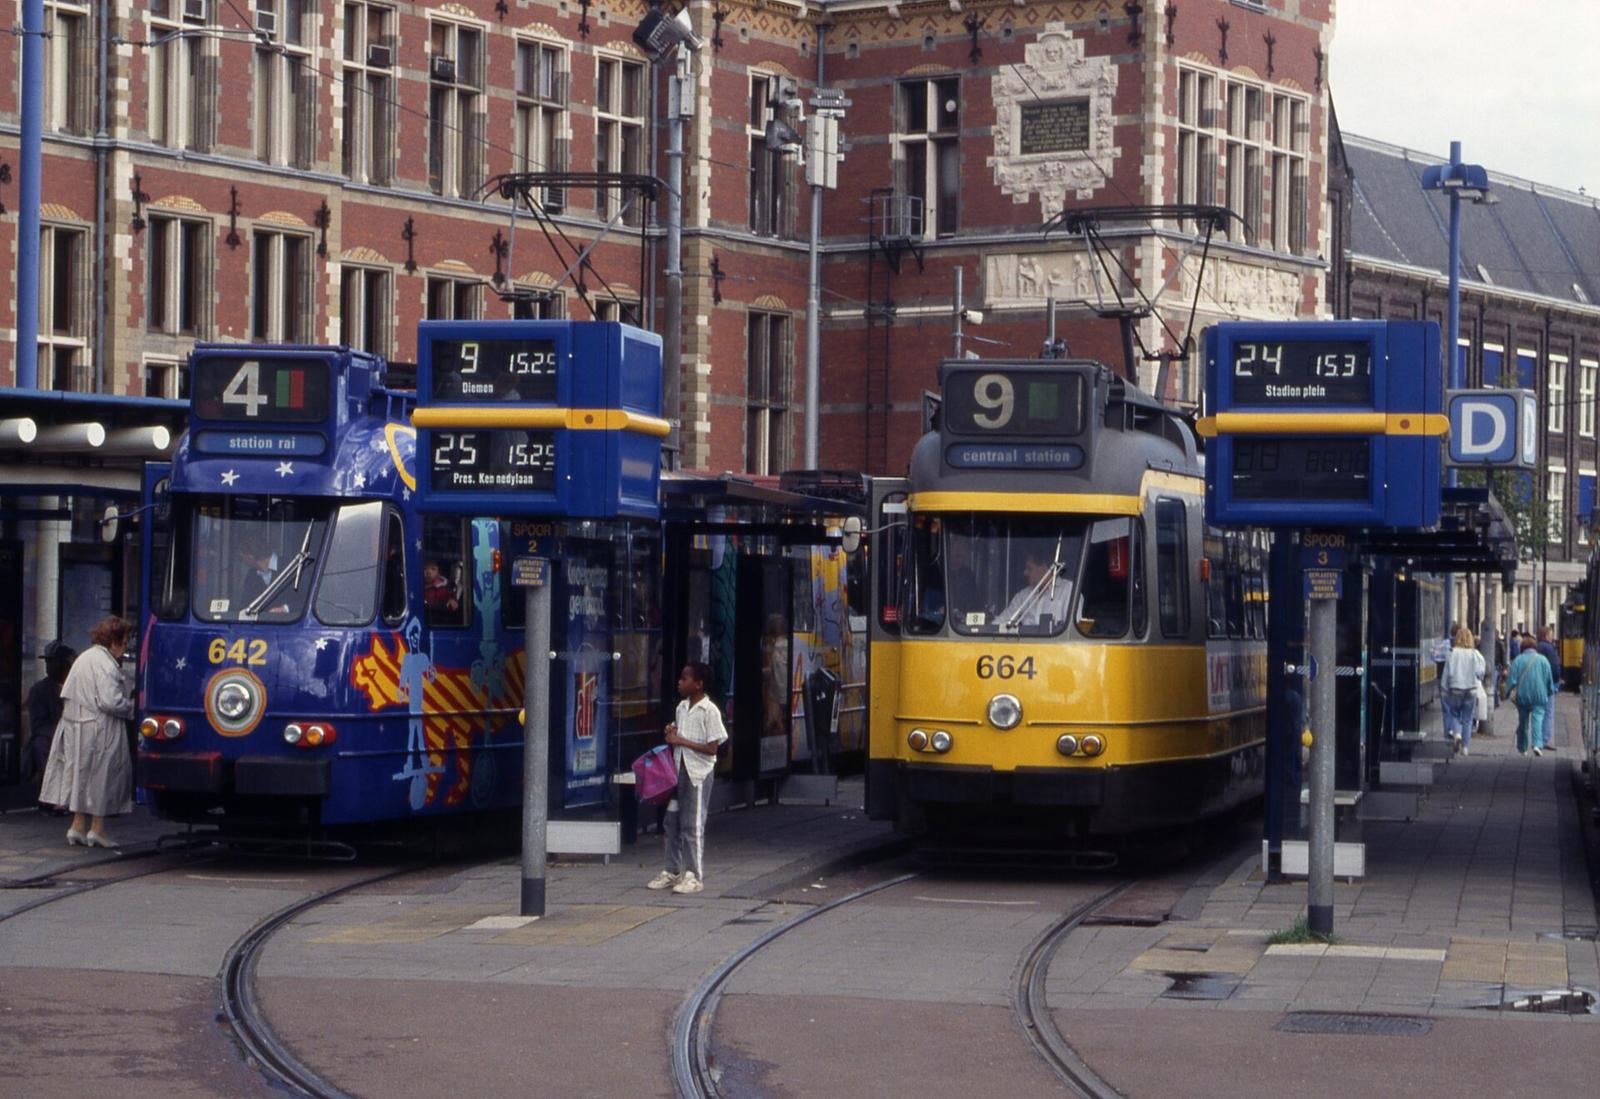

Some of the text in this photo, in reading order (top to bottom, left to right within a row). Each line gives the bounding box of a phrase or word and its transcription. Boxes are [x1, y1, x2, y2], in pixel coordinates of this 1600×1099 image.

[460, 342, 479, 374] 9
[1235, 344, 1282, 376] 24
[222, 361, 268, 417] 4
[462, 382, 494, 394] Diemen
[972, 373, 1015, 430] 9
[1461, 402, 1507, 455] D
[229, 436, 296, 449] station rai
[434, 434, 476, 465] 25
[962, 449, 1071, 463] centraal station
[453, 472, 476, 484] Pres.
[513, 523, 552, 537] SPOOR
[527, 540, 537, 553] 2
[1303, 533, 1346, 548] SPOOR
[1318, 551, 1329, 566] 3
[208, 638, 268, 666] 642
[976, 654, 1038, 680] 664
